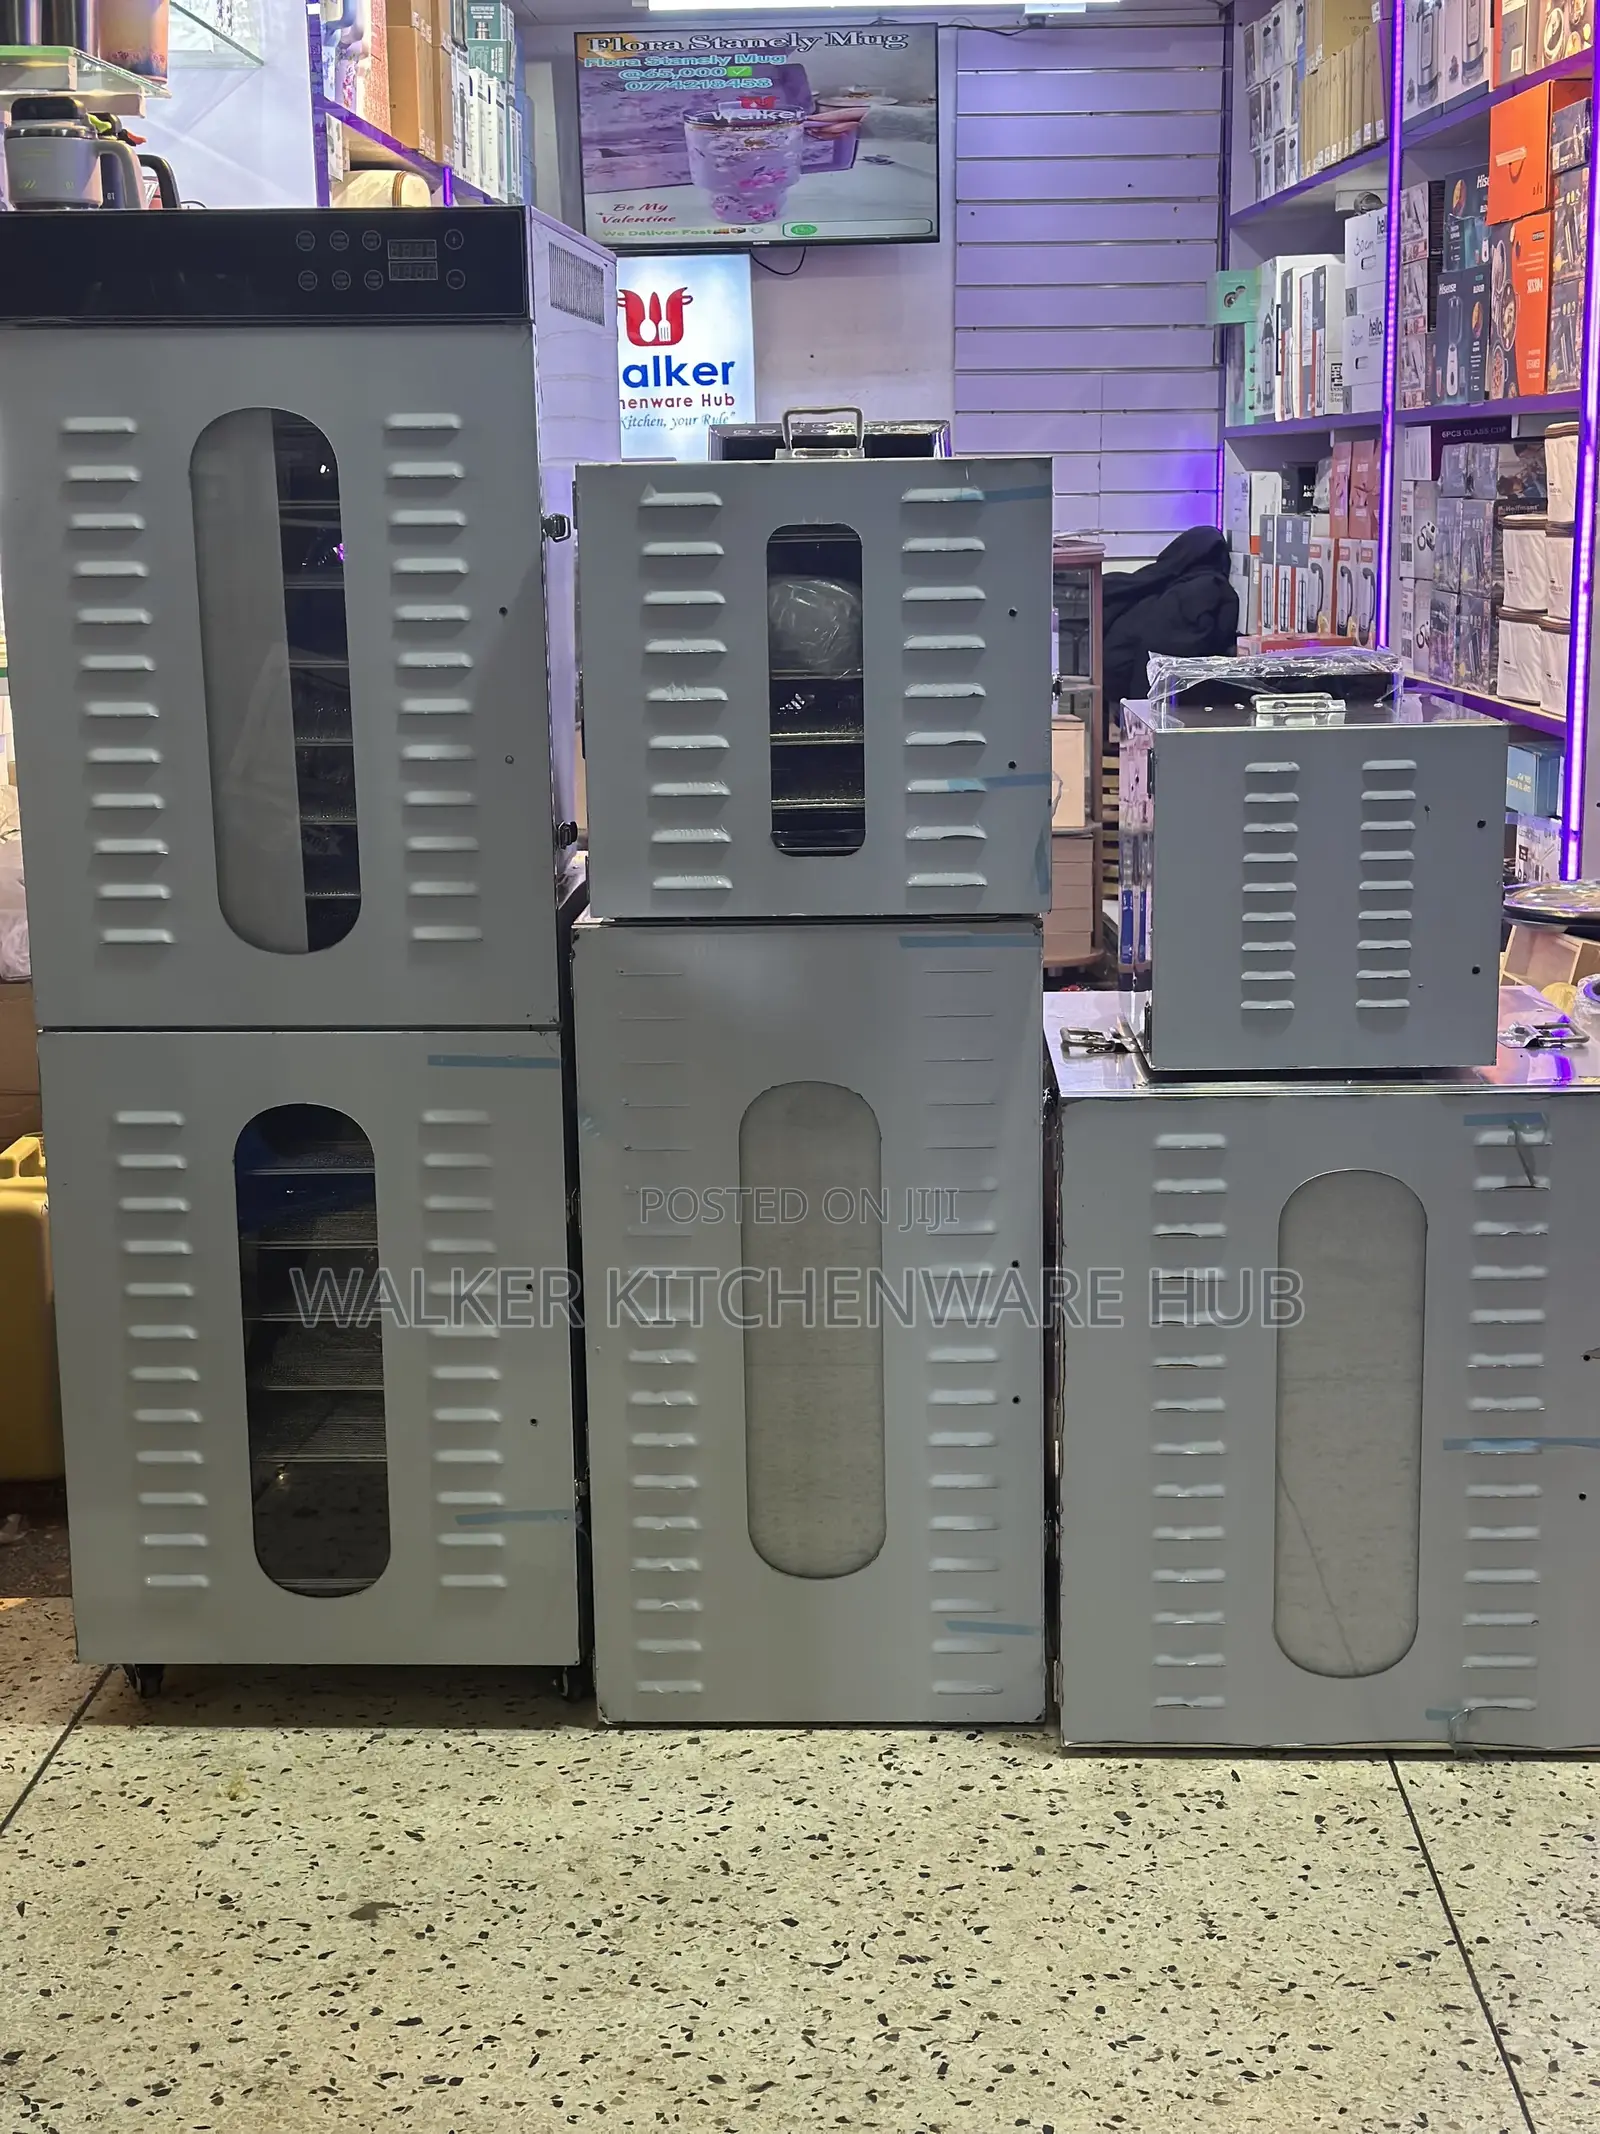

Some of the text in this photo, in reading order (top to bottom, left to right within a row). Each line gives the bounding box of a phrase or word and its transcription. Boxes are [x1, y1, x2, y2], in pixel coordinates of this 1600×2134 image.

[588, 31, 909, 52] Flora Stanely Mug
[584, 53, 786, 67] Flora Stanely Mug
[619, 66, 727, 79] @65,000
[613, 203, 668, 212] Be My
[601, 215, 676, 224] Valentine
[622, 355, 735, 388] alker
[702, 393, 735, 407] Hub
[669, 416, 698, 430] your
